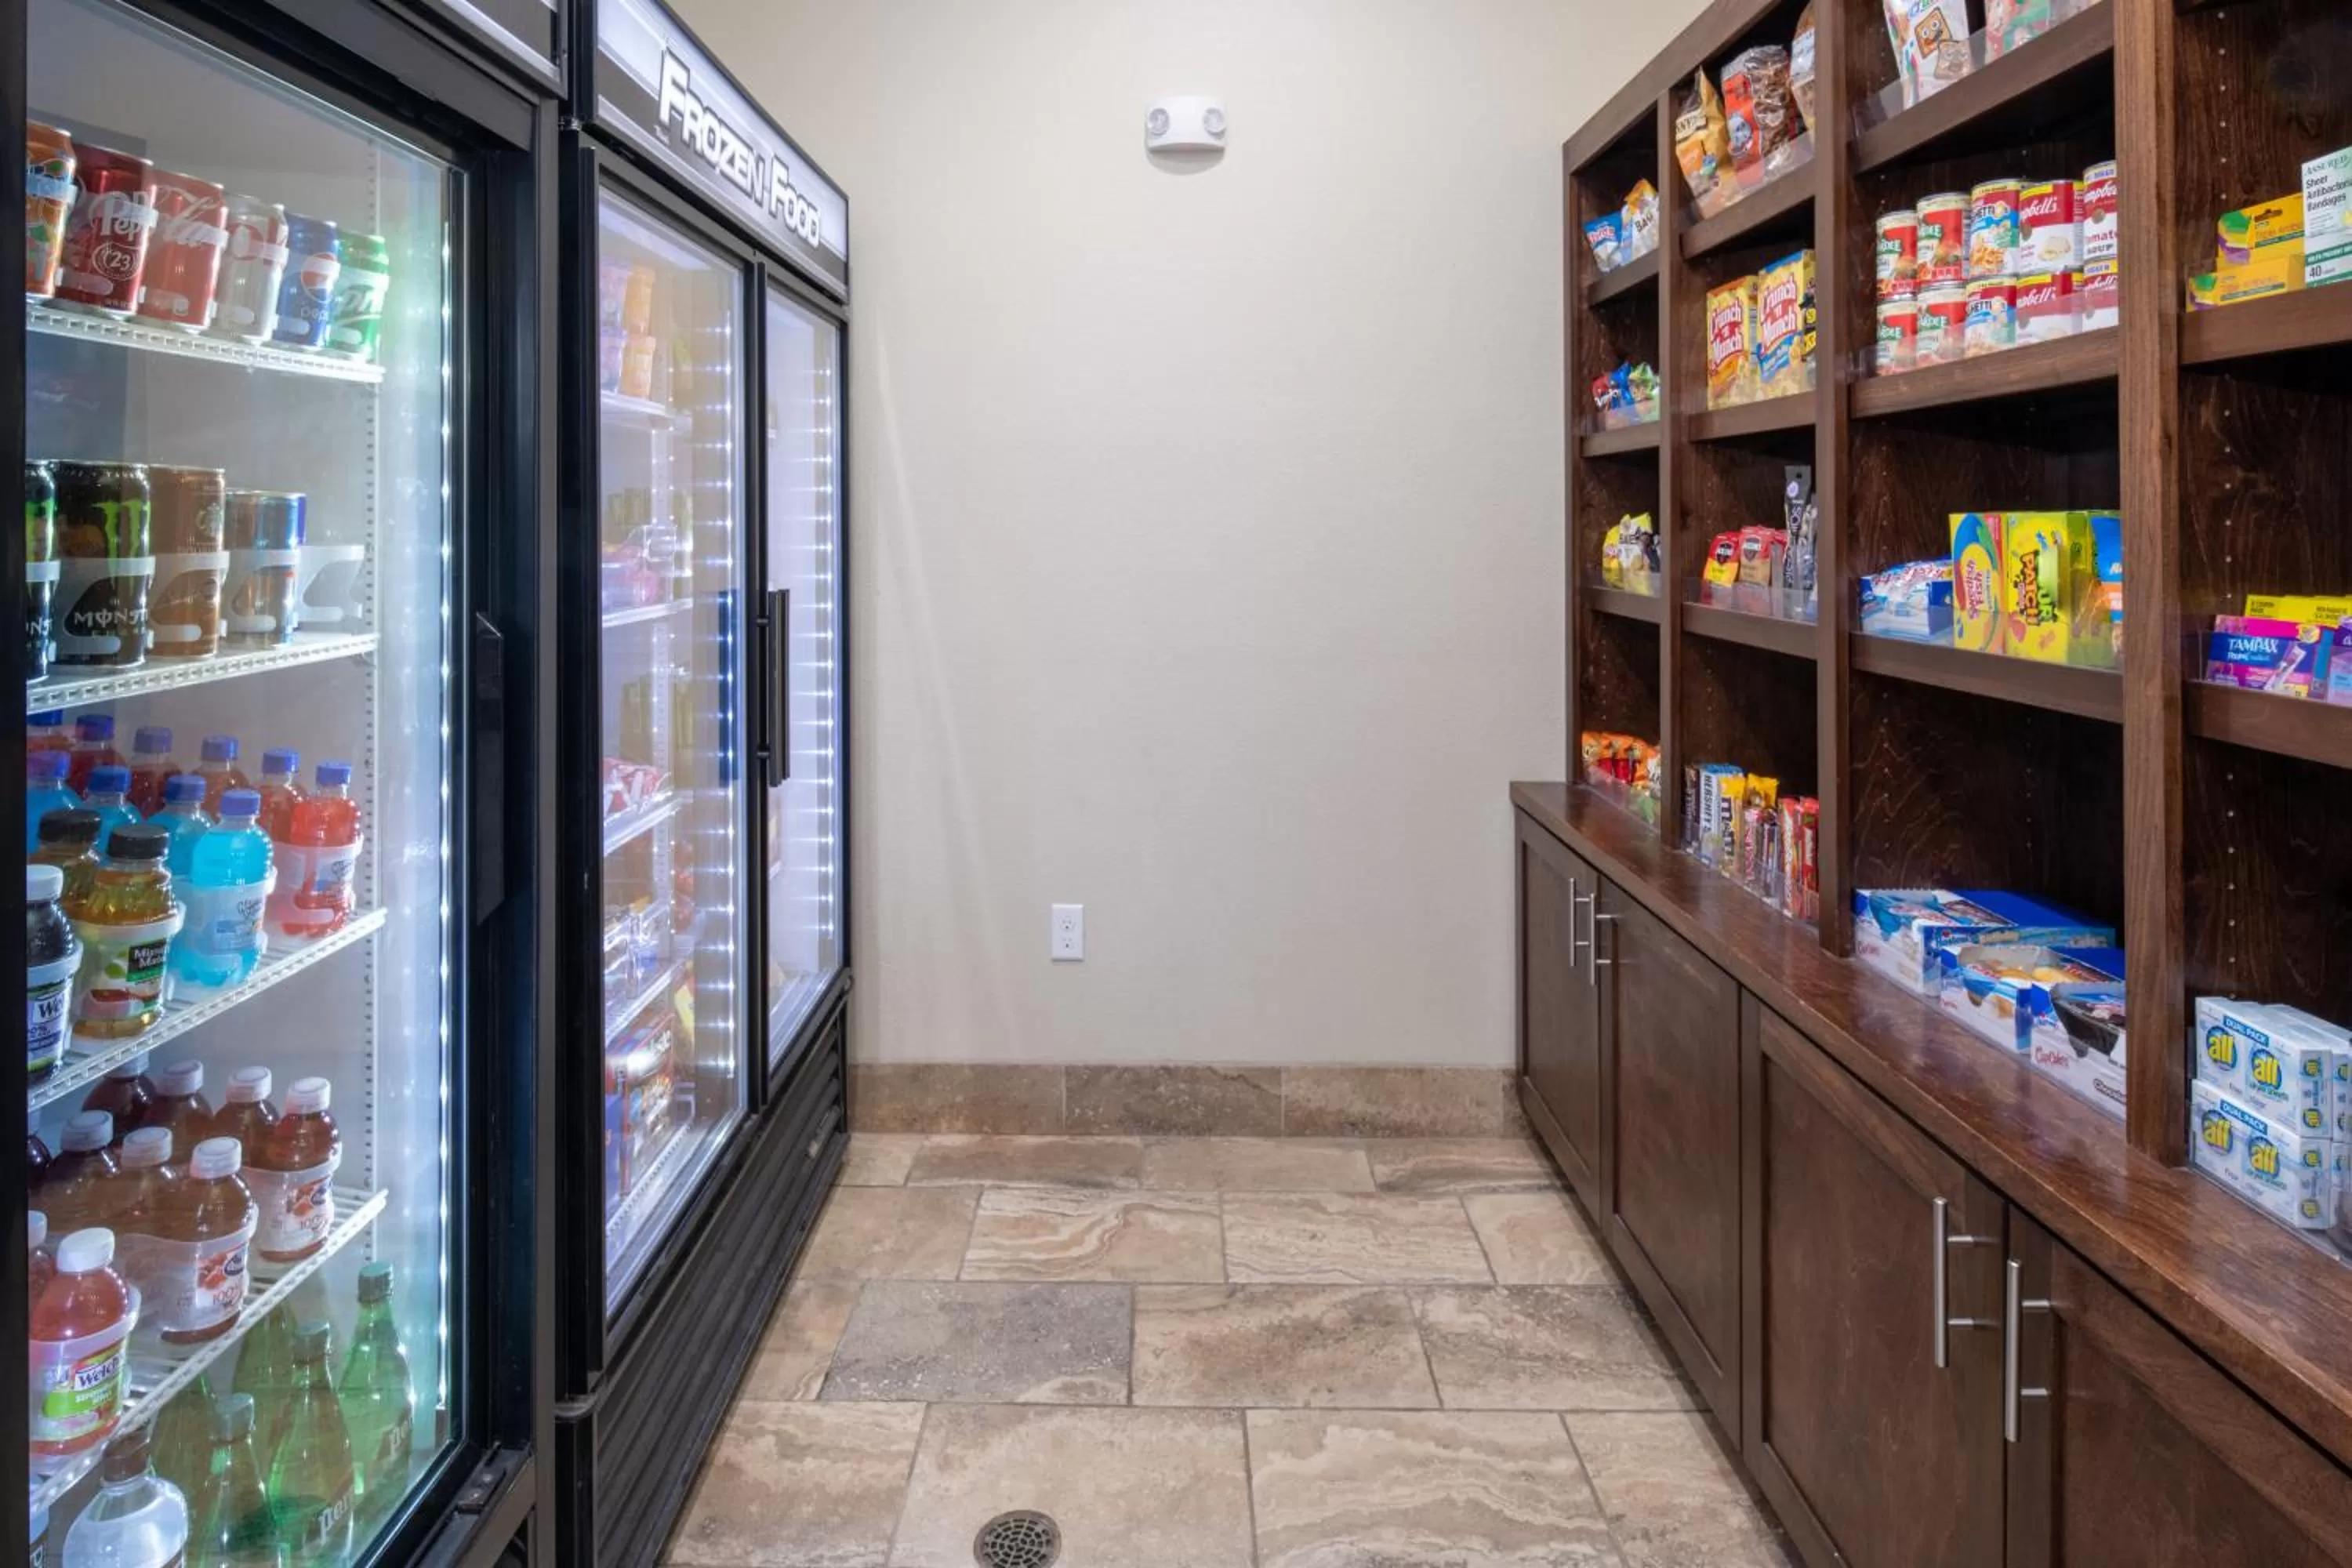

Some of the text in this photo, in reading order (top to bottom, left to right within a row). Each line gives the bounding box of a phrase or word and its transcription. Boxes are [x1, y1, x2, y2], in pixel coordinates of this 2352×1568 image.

[659, 46, 822, 249] FROZEN FOOD
[2307, 175, 2328, 189] Sheer
[2309, 265, 2321, 278] 40
[1965, 559, 1980, 621] Swedish
[1974, 571, 1985, 608] Fish
[2020, 550, 2039, 626] PATCH
[2227, 636, 2279, 653] TAMPAX
[2207, 1034, 2234, 1065] all
[2245, 1028, 2267, 1046] PACK
[2252, 1055, 2279, 1087] all
[2204, 1119, 2232, 1149] all
[2243, 1114, 2265, 1132] PACK
[2251, 1145, 2278, 1174] all
